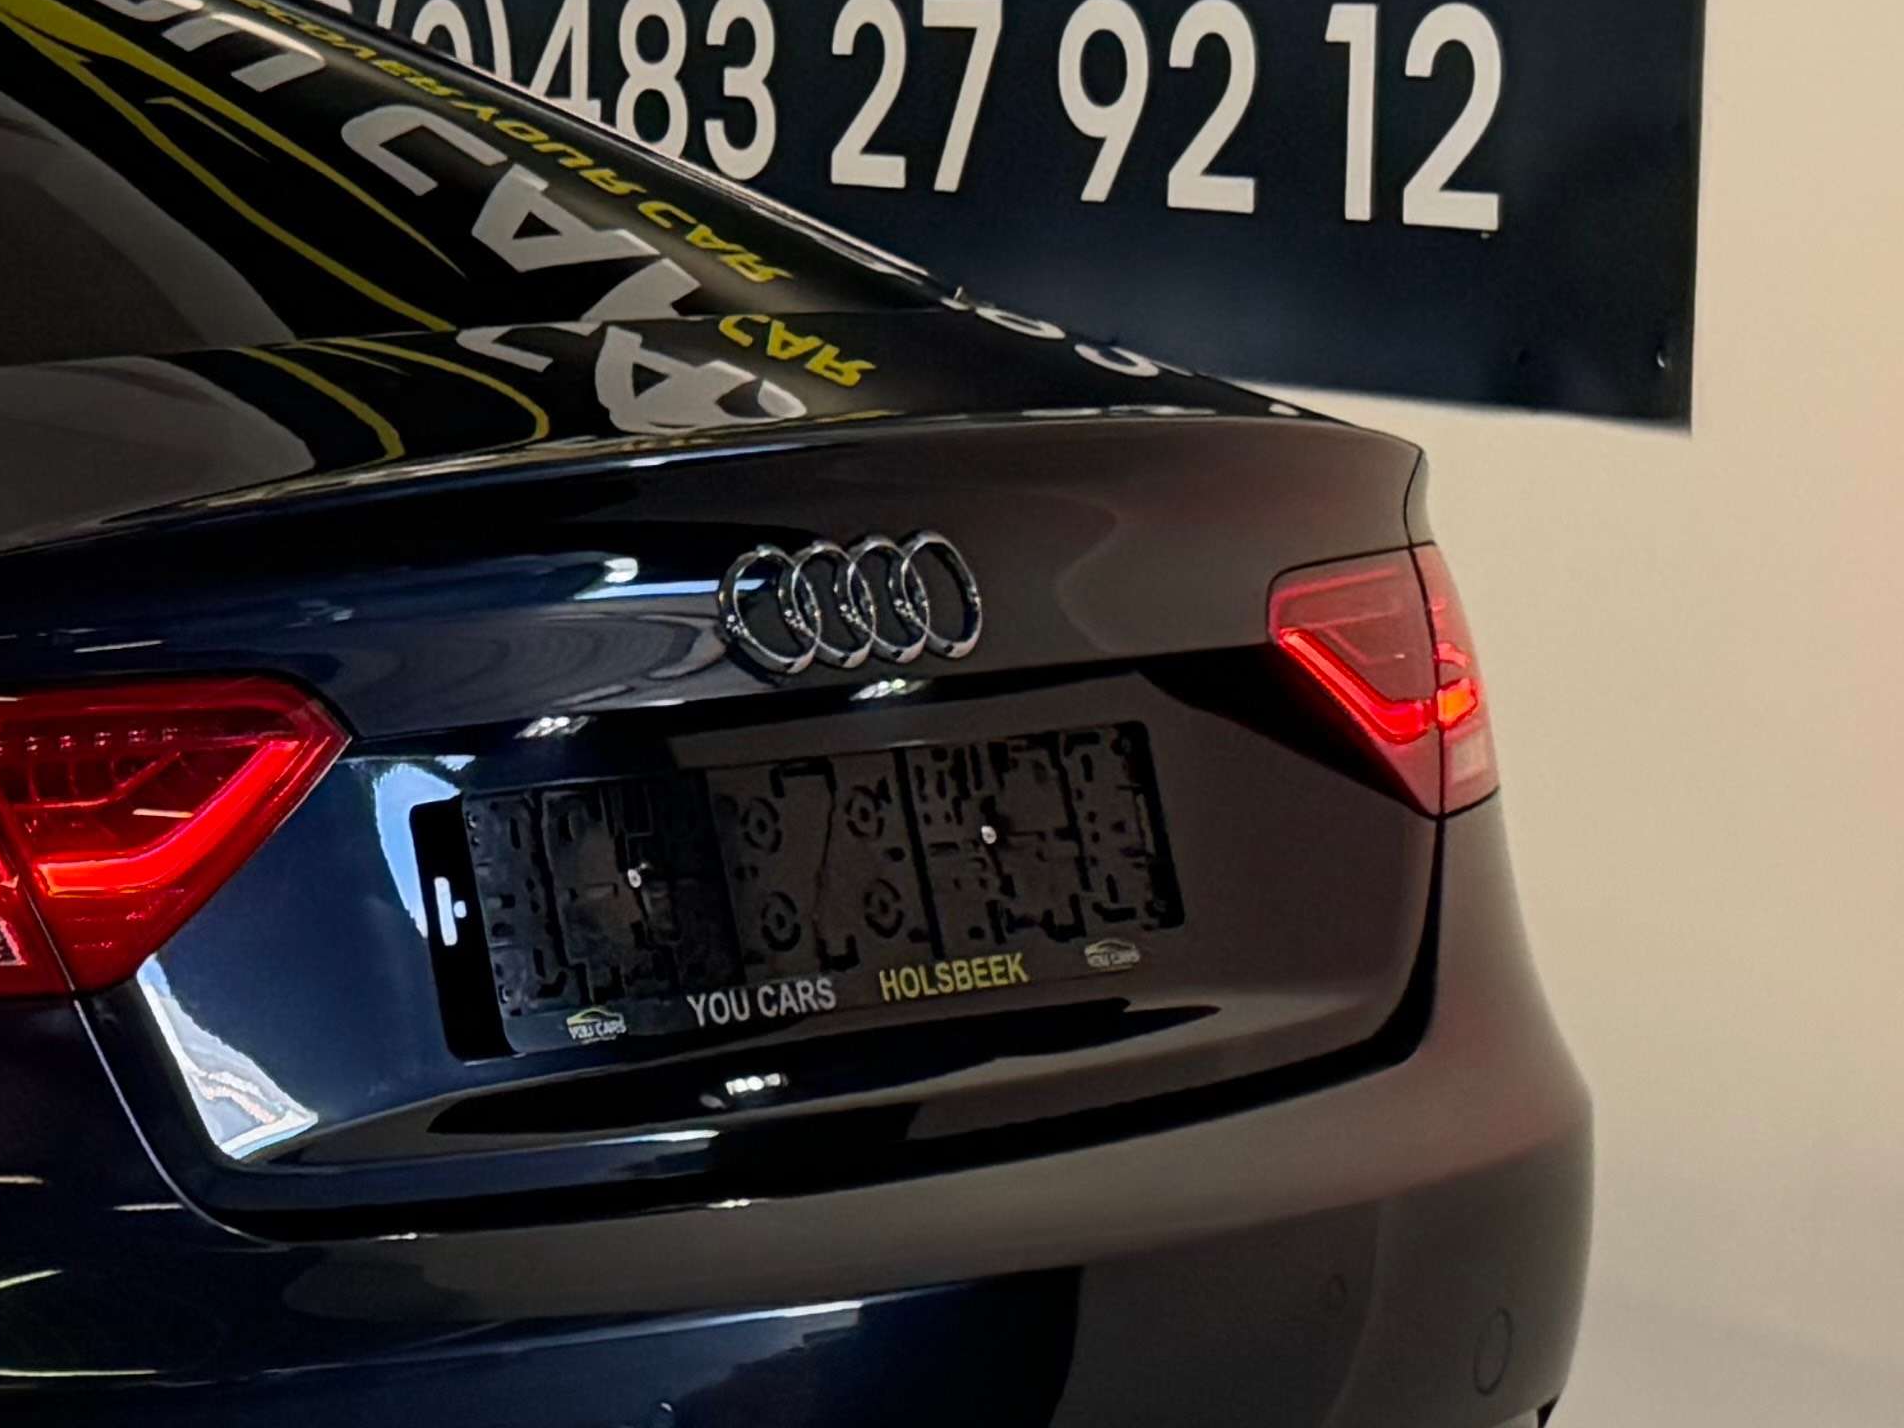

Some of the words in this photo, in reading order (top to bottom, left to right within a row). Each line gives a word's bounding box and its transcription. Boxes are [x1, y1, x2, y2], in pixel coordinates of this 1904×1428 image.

[1324, 2, 1500, 231] 12
[687, 986, 750, 1027] YOU
[757, 976, 837, 1018] CARS
[878, 951, 1030, 1002] HOLSBEEK
